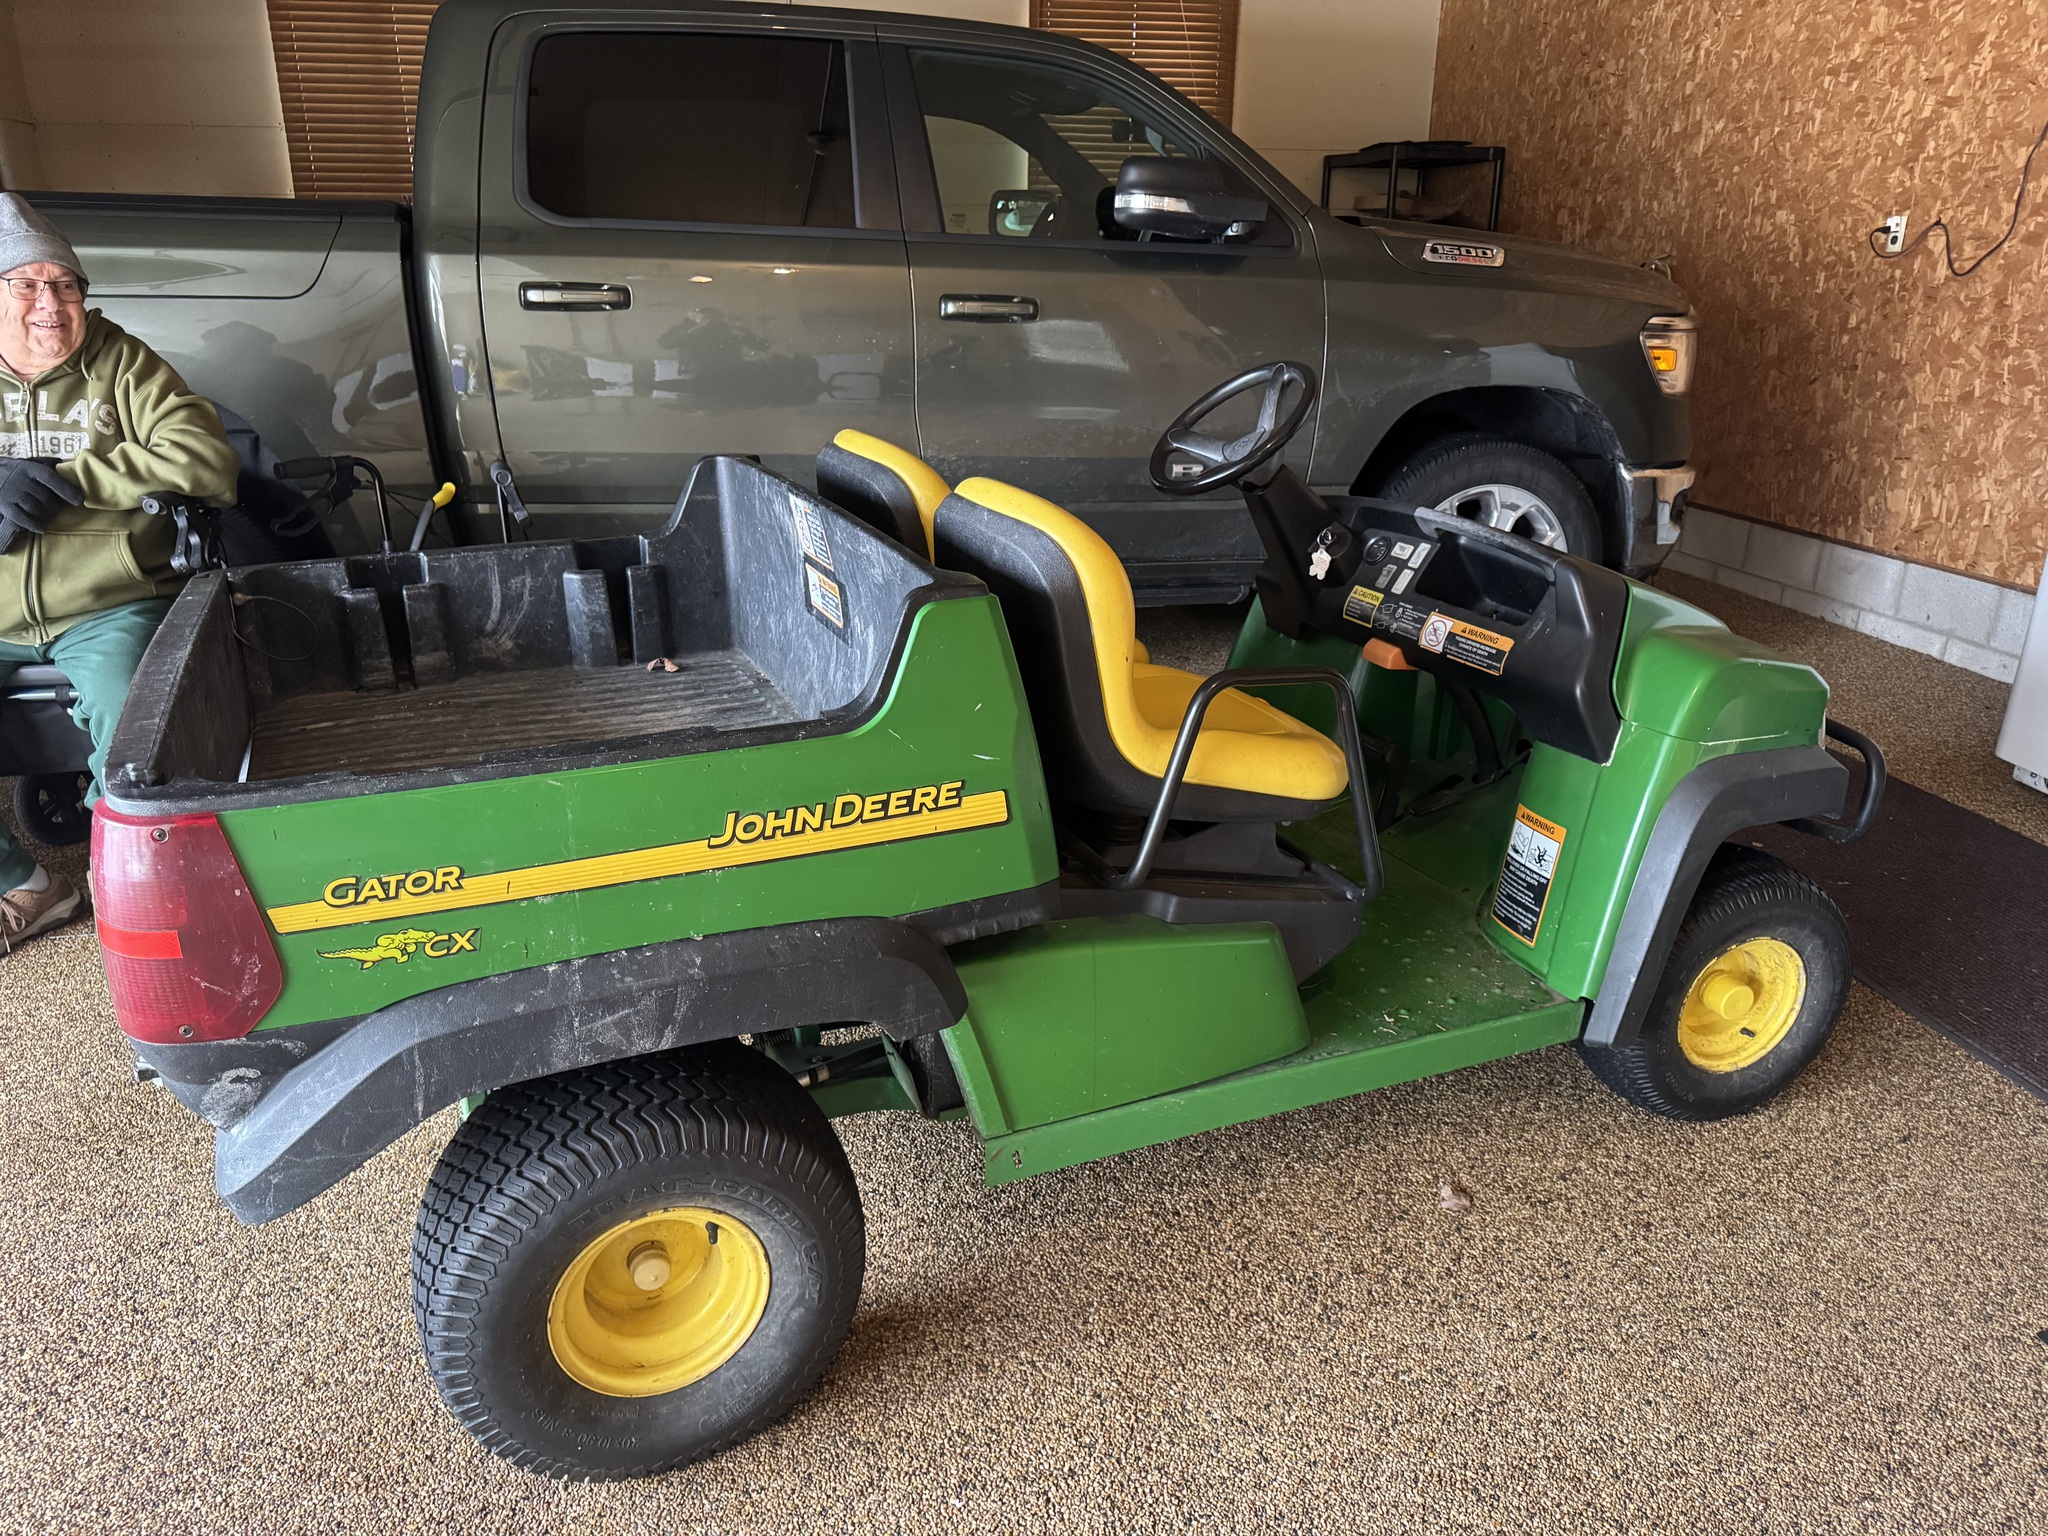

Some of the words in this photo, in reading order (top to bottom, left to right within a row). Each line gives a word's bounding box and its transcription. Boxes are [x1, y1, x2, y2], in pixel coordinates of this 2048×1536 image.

[1433, 244, 1494, 258] 1500
[0, 390, 117, 436] ELA'S
[40, 436, 82, 455] 1961
[1357, 590, 1379, 602] CAUTION
[1468, 628, 1499, 645] WARNING
[708, 804, 824, 849] JOHN
[832, 780, 964, 827] DEERE
[1525, 814, 1556, 835] WARNING
[323, 865, 465, 908] GATOR
[424, 929, 477, 958] CX
